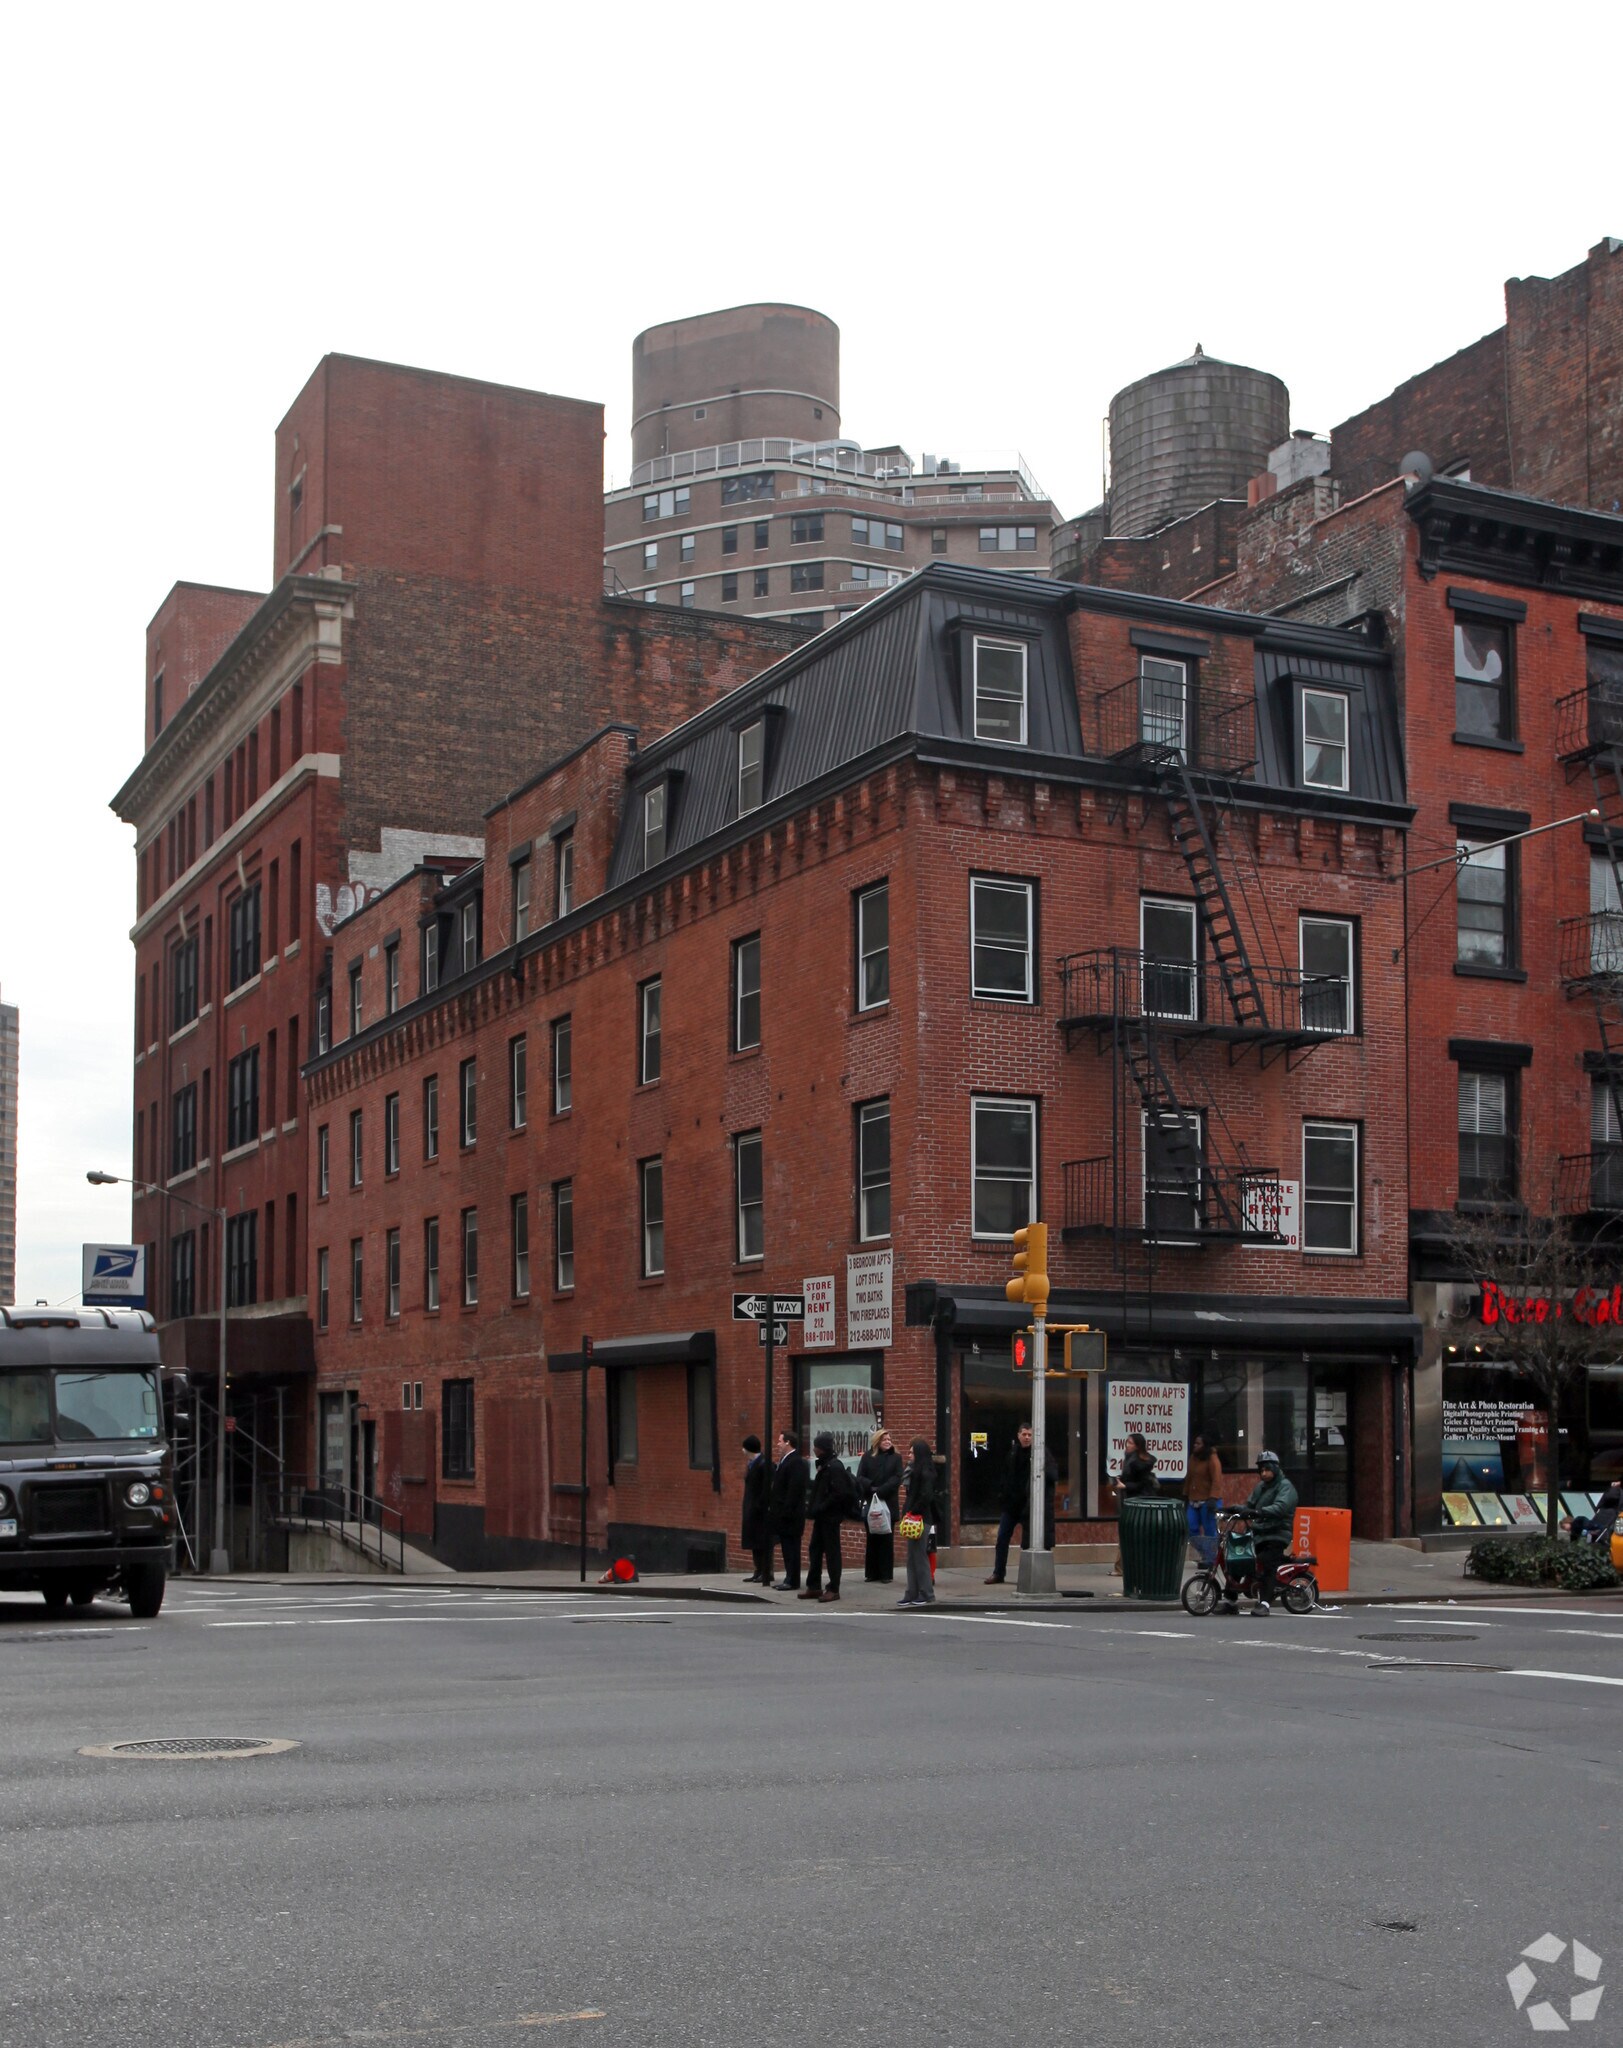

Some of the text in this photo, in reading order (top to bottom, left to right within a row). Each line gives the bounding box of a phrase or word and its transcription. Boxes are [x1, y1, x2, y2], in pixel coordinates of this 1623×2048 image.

[1248, 1184, 1294, 1194] SORE
[1248, 1204, 1292, 1216] RENT
[849, 1253, 891, 1270] 3 BEDROOM APT'S
[855, 1272, 883, 1286] LOFT STYLE
[806, 1281, 832, 1291] STORE
[811, 1292, 826, 1301] FOR
[856, 1290, 883, 1304] TWO BATHS
[747, 1302, 798, 1312] ONE WAY
[807, 1302, 831, 1313] RENT
[850, 1307, 890, 1322] TWO FIREPLACES
[814, 1317, 824, 1328] 212
[805, 1330, 834, 1342] 688-0700
[849, 1327, 891, 1342] 212-688-0700
[1112, 1385, 1186, 1399] 3 BEDROOM APT'S
[815, 1388, 834, 1414] STORE
[837, 1388, 848, 1414] FOR
[1443, 1400, 1534, 1410] Fine Art & Photo Restoration
[1124, 1404, 1173, 1416] LOFT STYLE
[1501, 1411, 1524, 1419] Printing
[1124, 1421, 1172, 1434] TWO BATHS
[1470, 1418, 1483, 1426] Fine
[1485, 1418, 1494, 1426] Art
[1495, 1418, 1518, 1427] Printing
[1469, 1426, 1490, 1434] Quality
[1514, 1426, 1538, 1435] Framing
[1443, 1434, 1465, 1442] Gallery
[1112, 1438, 1183, 1451] TW EPLACES
[1110, 1458, 1184, 1472] 21-0700
